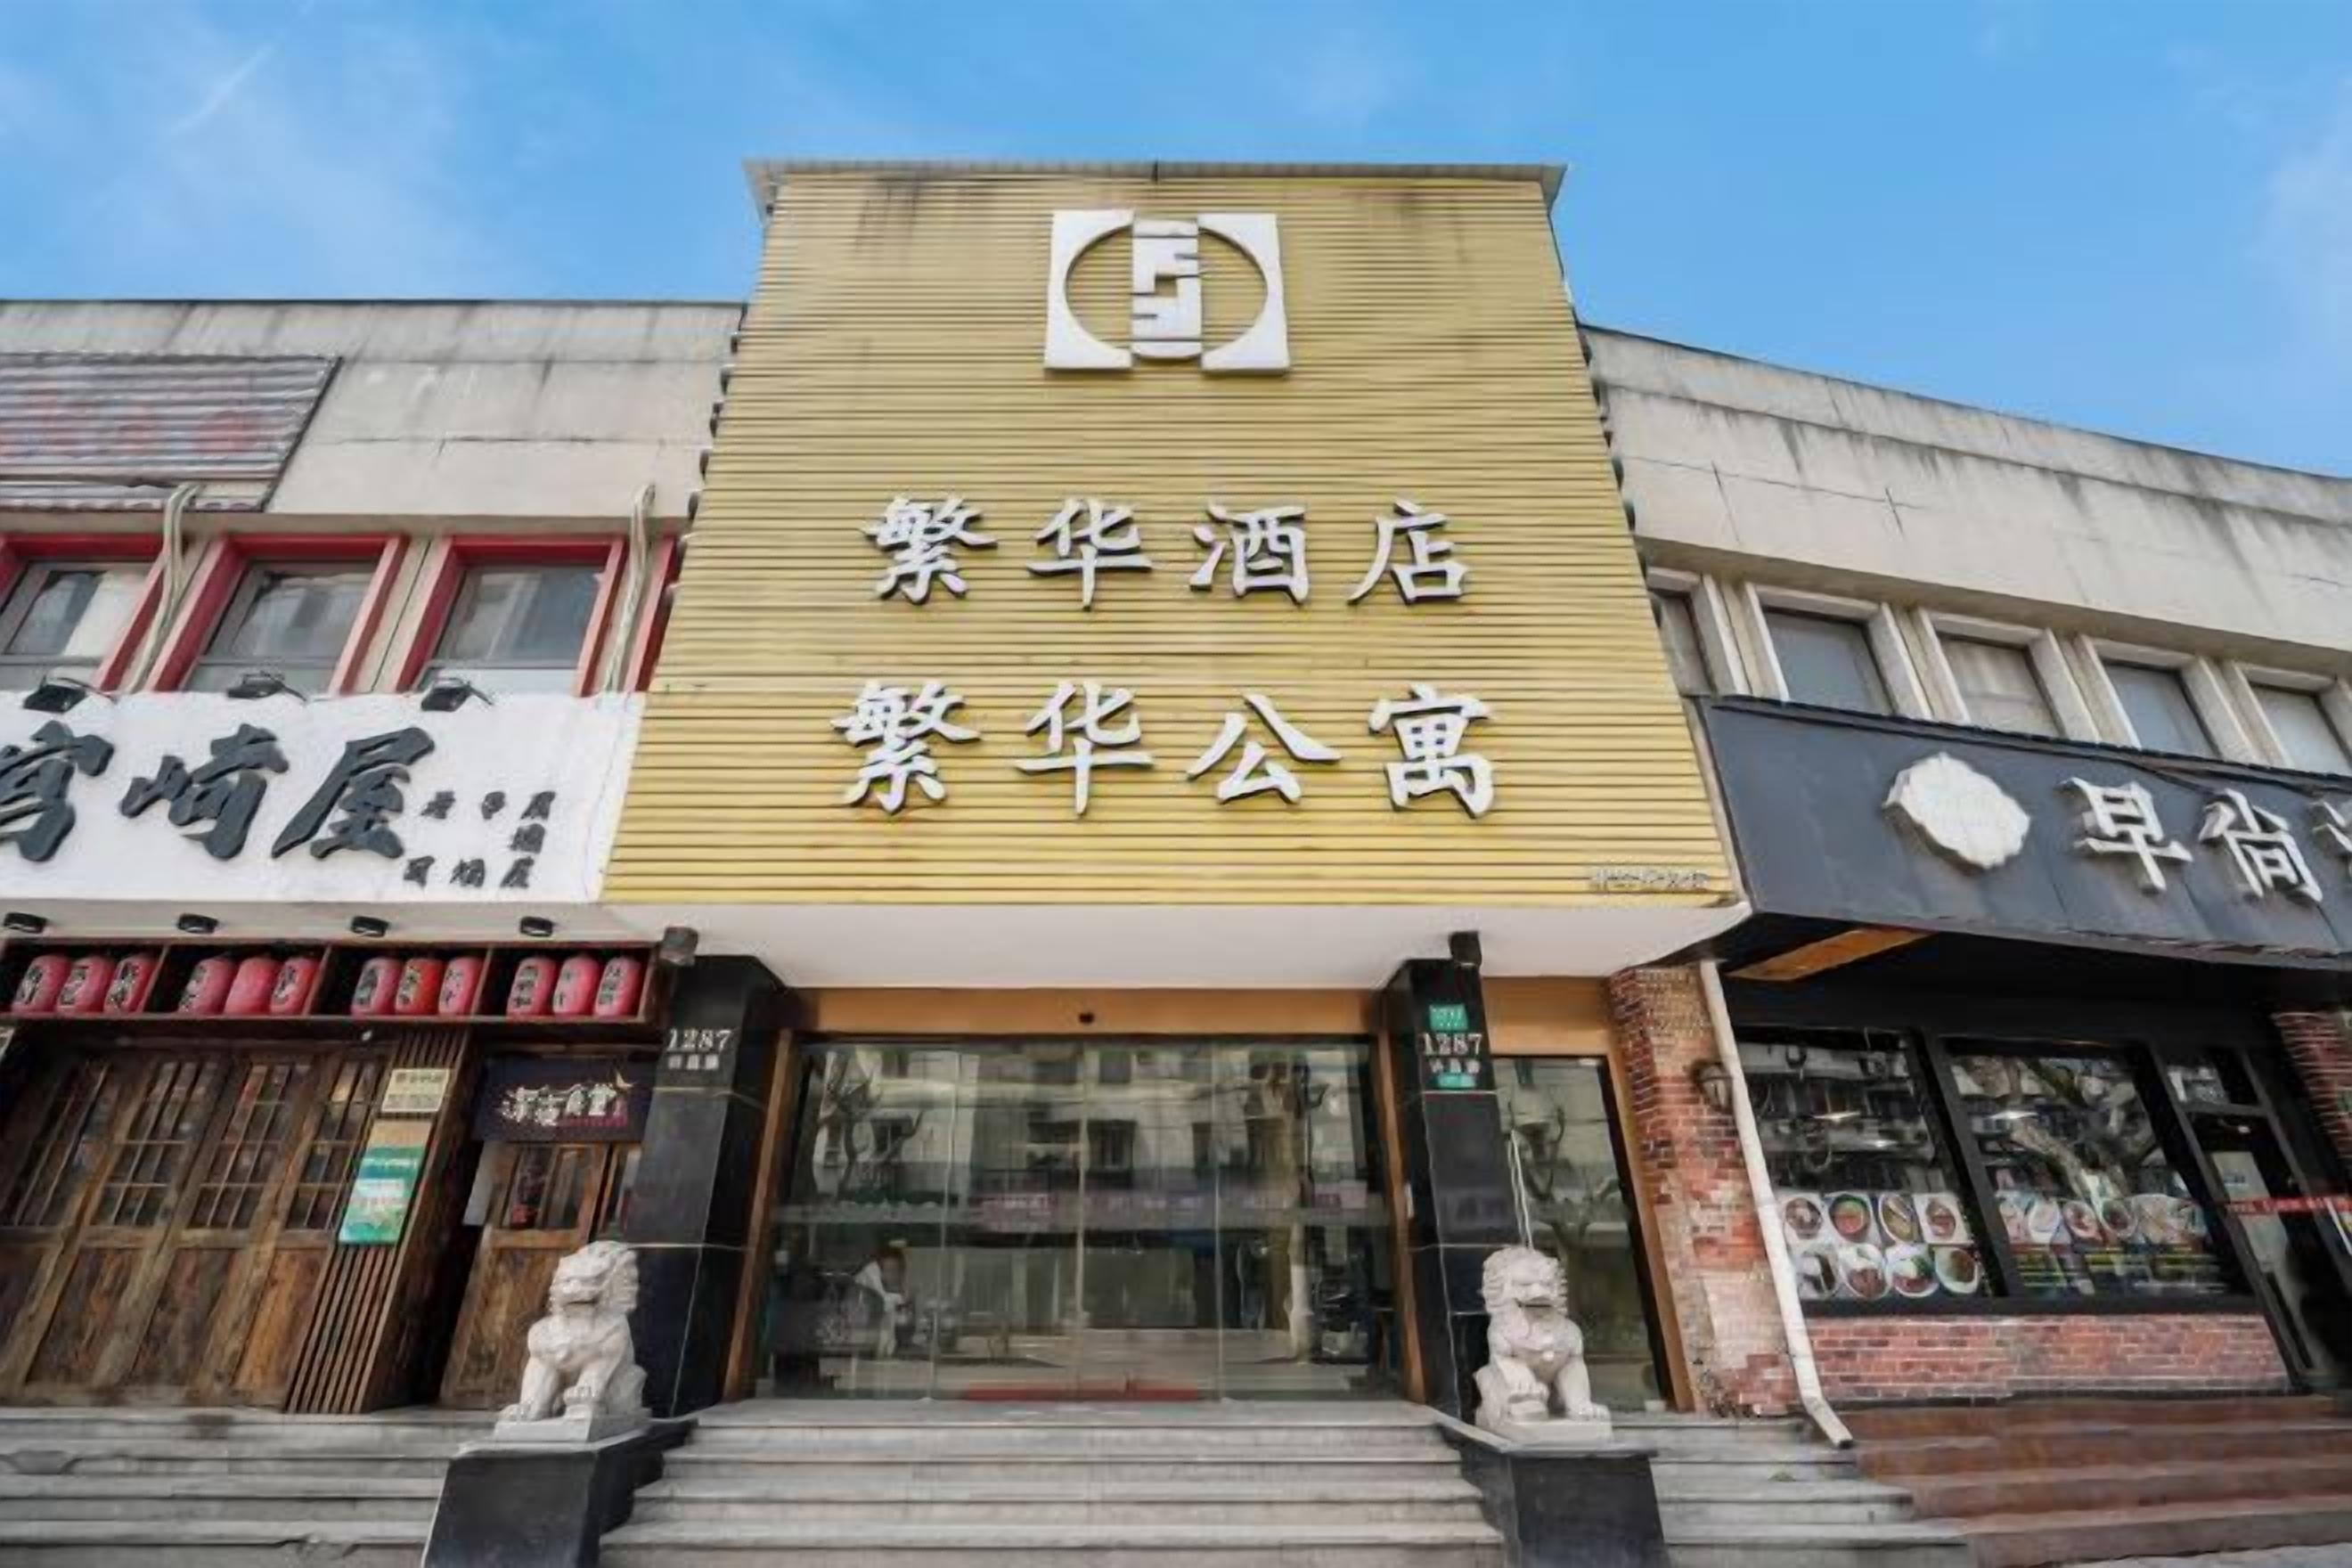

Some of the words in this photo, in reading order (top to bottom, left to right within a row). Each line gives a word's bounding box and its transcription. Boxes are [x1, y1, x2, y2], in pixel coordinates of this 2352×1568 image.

[862, 493, 1469, 611] 繁华酒店
[829, 679, 1497, 818] 繁华公寓
[2058, 777, 2352, 902] 早尚
